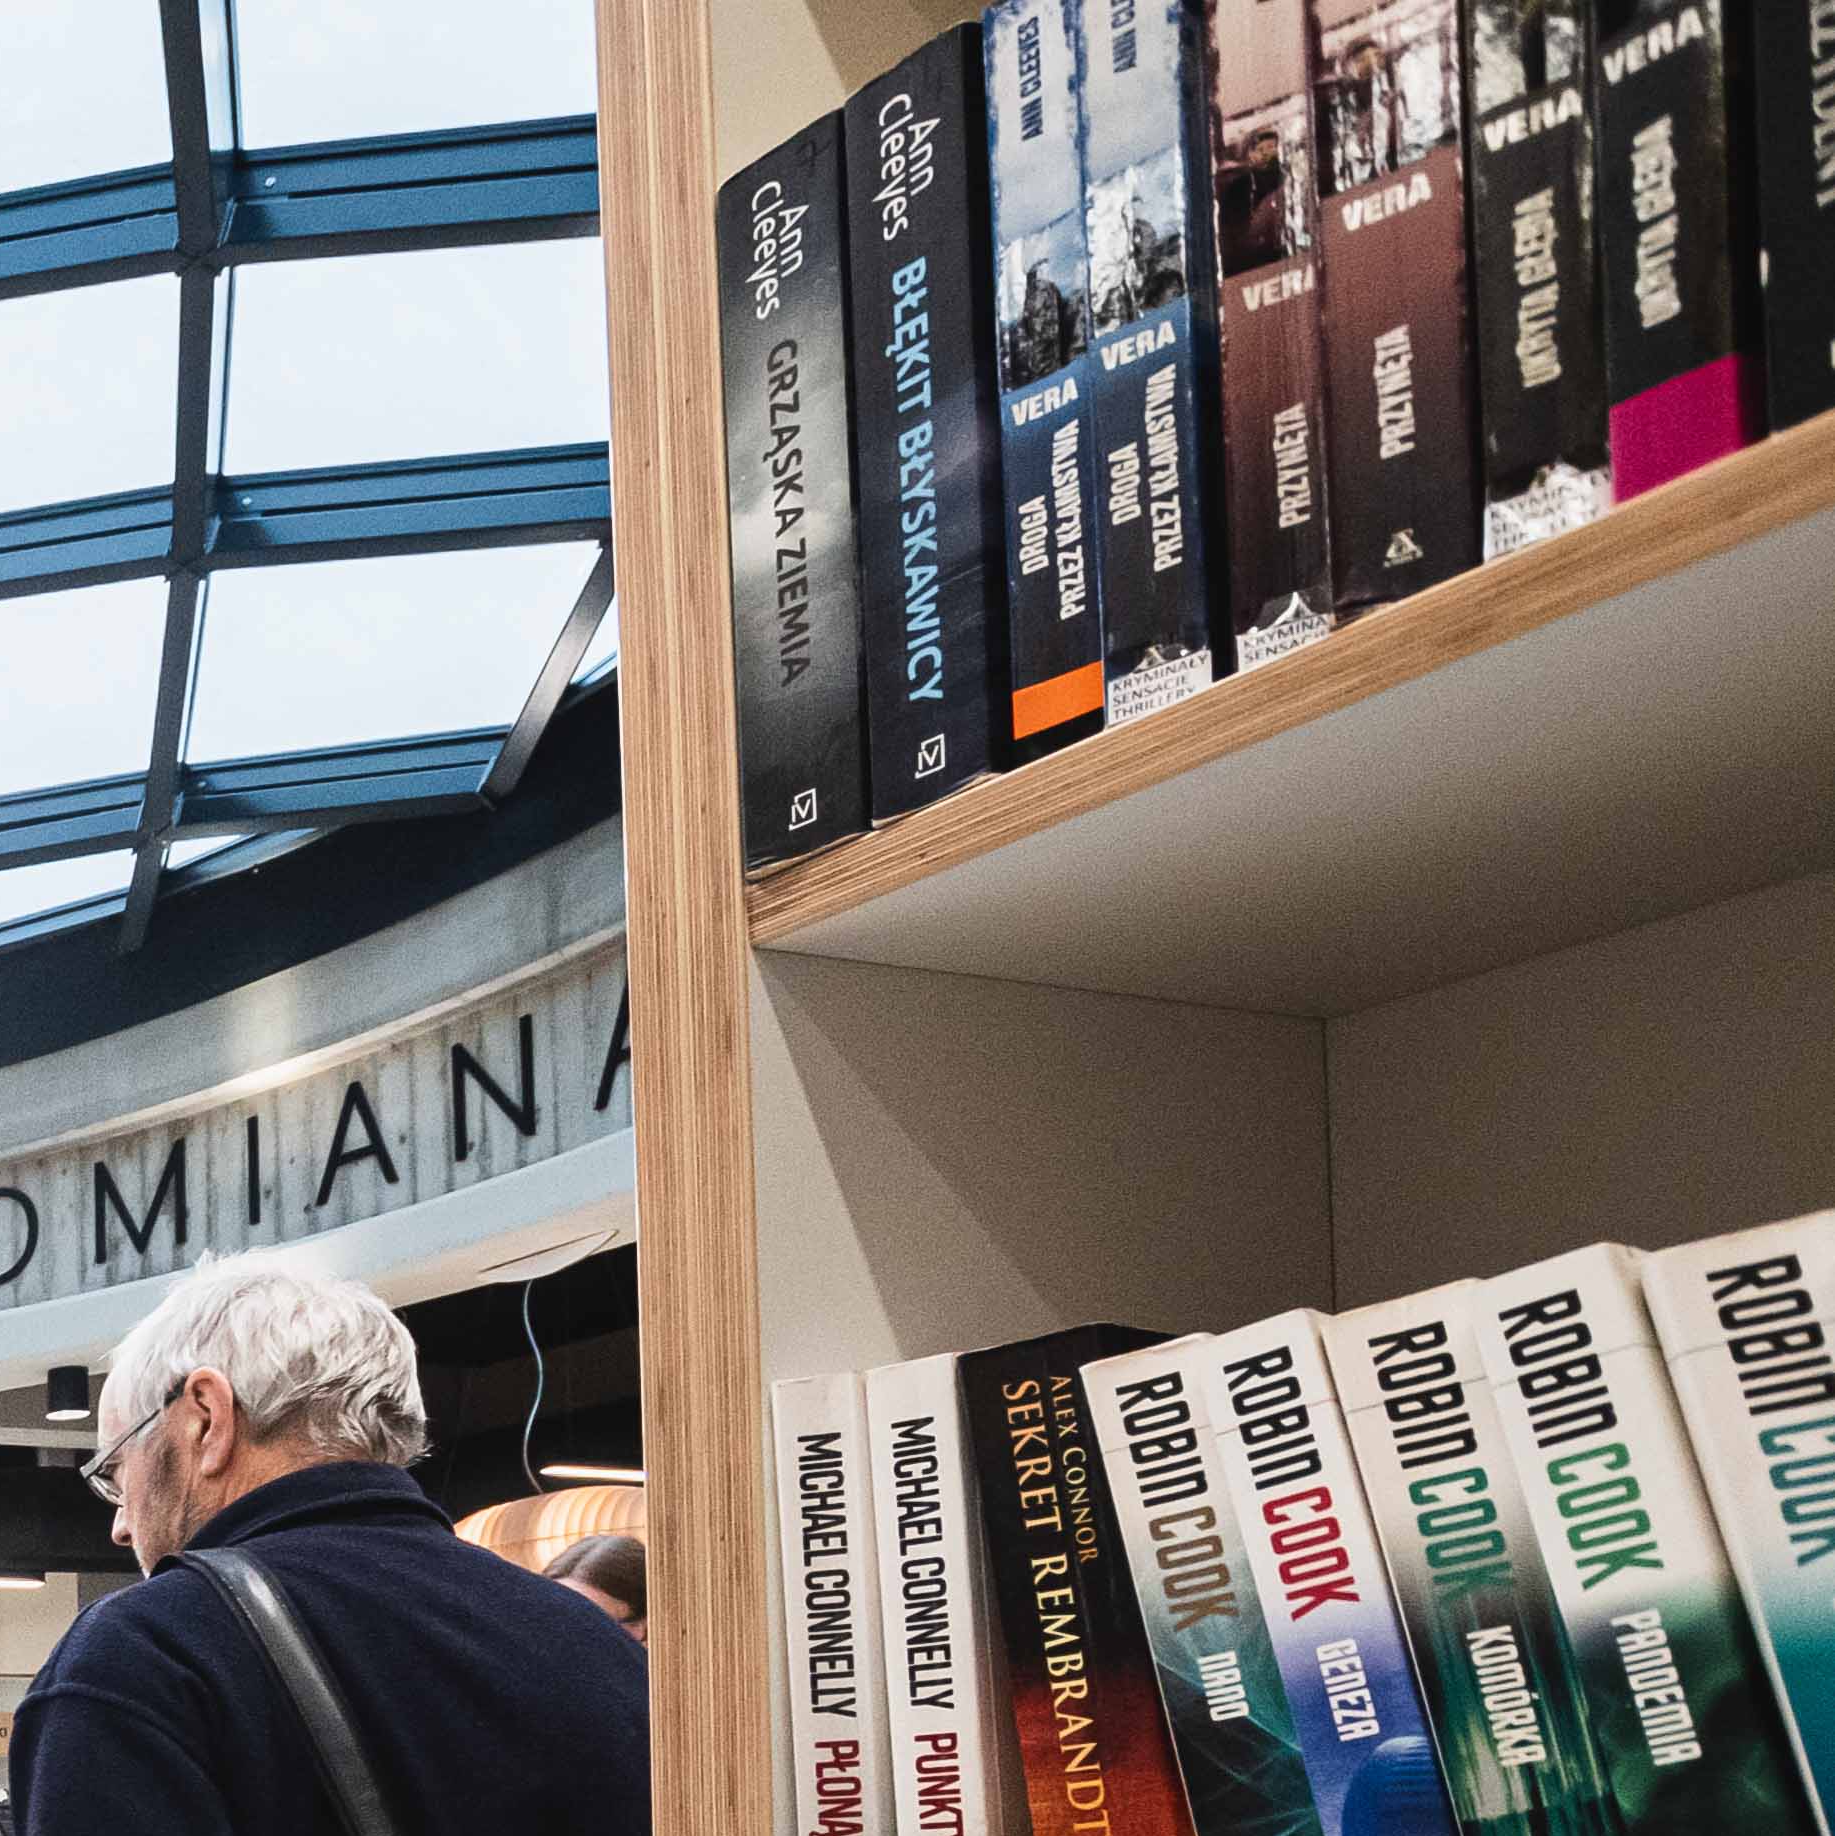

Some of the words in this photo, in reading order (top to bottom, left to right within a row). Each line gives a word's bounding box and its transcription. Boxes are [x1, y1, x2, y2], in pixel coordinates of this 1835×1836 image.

[1016, 15, 1042, 96] CLEEVES
[1111, 28, 1138, 74] ANN
[1602, 6, 1706, 85] VERA
[873, 92, 913, 241] Cleeves
[907, 118, 941, 196] Ann
[1019, 98, 1044, 141] ANN
[1483, 87, 1583, 152] VERA
[746, 180, 784, 320] Cleeves
[778, 203, 810, 278] Ann
[1340, 172, 1434, 234] VERA
[885, 256, 932, 414] BŁĘKIT
[1100, 320, 1178, 372] VERA
[763, 338, 805, 539] GRZĄSKA
[1012, 376, 1079, 428] VERA
[1143, 362, 1179, 498] KŁAMSTWA
[1017, 495, 1049, 576] DROGA
[1050, 418, 1083, 547] KŁAMSTWA
[1107, 440, 1143, 526] DROGA
[1150, 493, 1184, 572] PRZEZ
[775, 539, 811, 688] ZIEMIA
[896, 420, 944, 704] BŁYSKAWICY
[1057, 546, 1088, 621] PRZEZ
[1113, 656, 1208, 693] KRYMINAŁY
[1001, 1378, 1063, 1536] SEKRET
[1050, 1373, 1080, 1439] ALEX
[797, 1430, 849, 1567] MICHAEL
[890, 1415, 943, 1556] MICHAEL
[1061, 1444, 1100, 1566] CONNOR
[1148, 1504, 1241, 1634] COOK
[1261, 1489, 1361, 1622] COOK
[1546, 1439, 1667, 1592] COOK
[1608, 1606, 1704, 1768] PANDEMIA
[806, 1570, 858, 1719] CONNELLY
[905, 1558, 956, 1711] CONNELLY
[1406, 1468, 1505, 1612] COOK
[1466, 1624, 1547, 1769] KOMÓRKA
